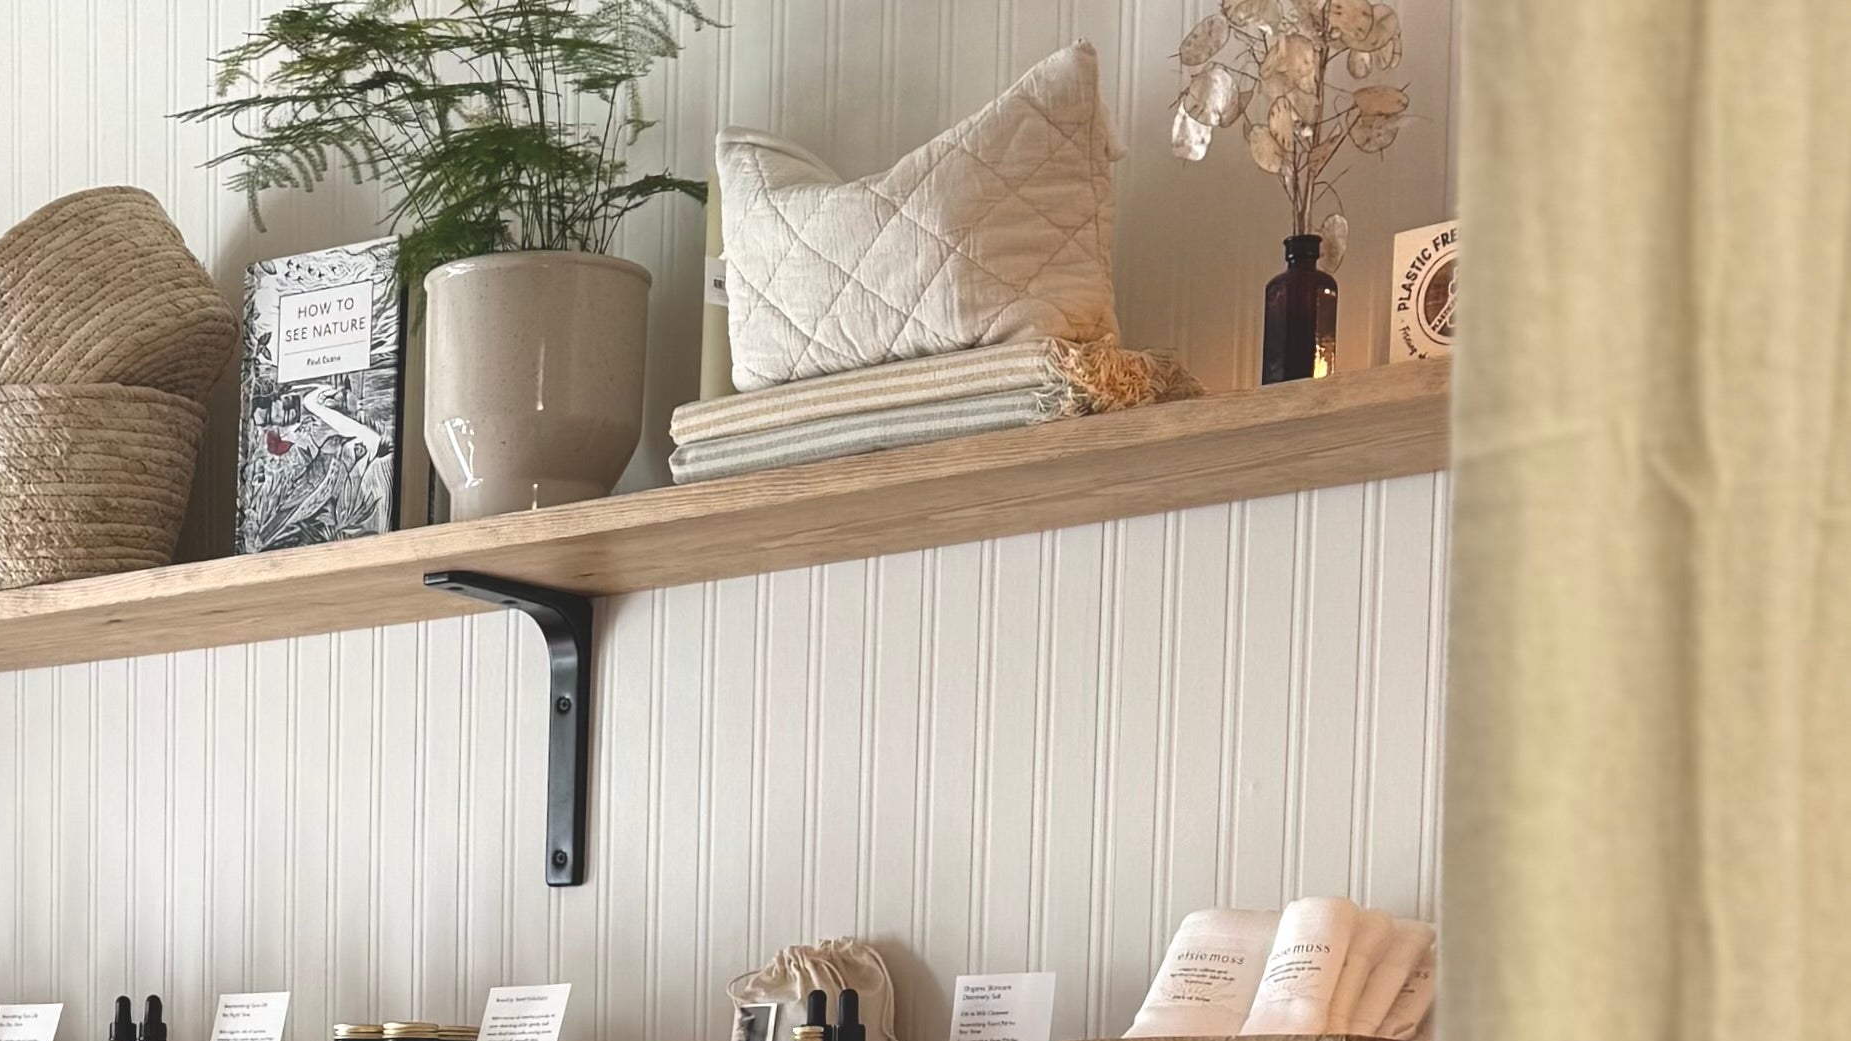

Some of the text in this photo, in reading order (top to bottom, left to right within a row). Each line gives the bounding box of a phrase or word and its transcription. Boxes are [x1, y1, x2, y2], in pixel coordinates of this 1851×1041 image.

[1397, 248, 1432, 312] PLASTIC
[1432, 227, 1458, 252] FRE
[297, 296, 356, 319] HOW TO
[285, 316, 367, 343] SEE NATURE
[1177, 949, 1246, 965] elsie moss
[1293, 943, 1332, 955] moss
